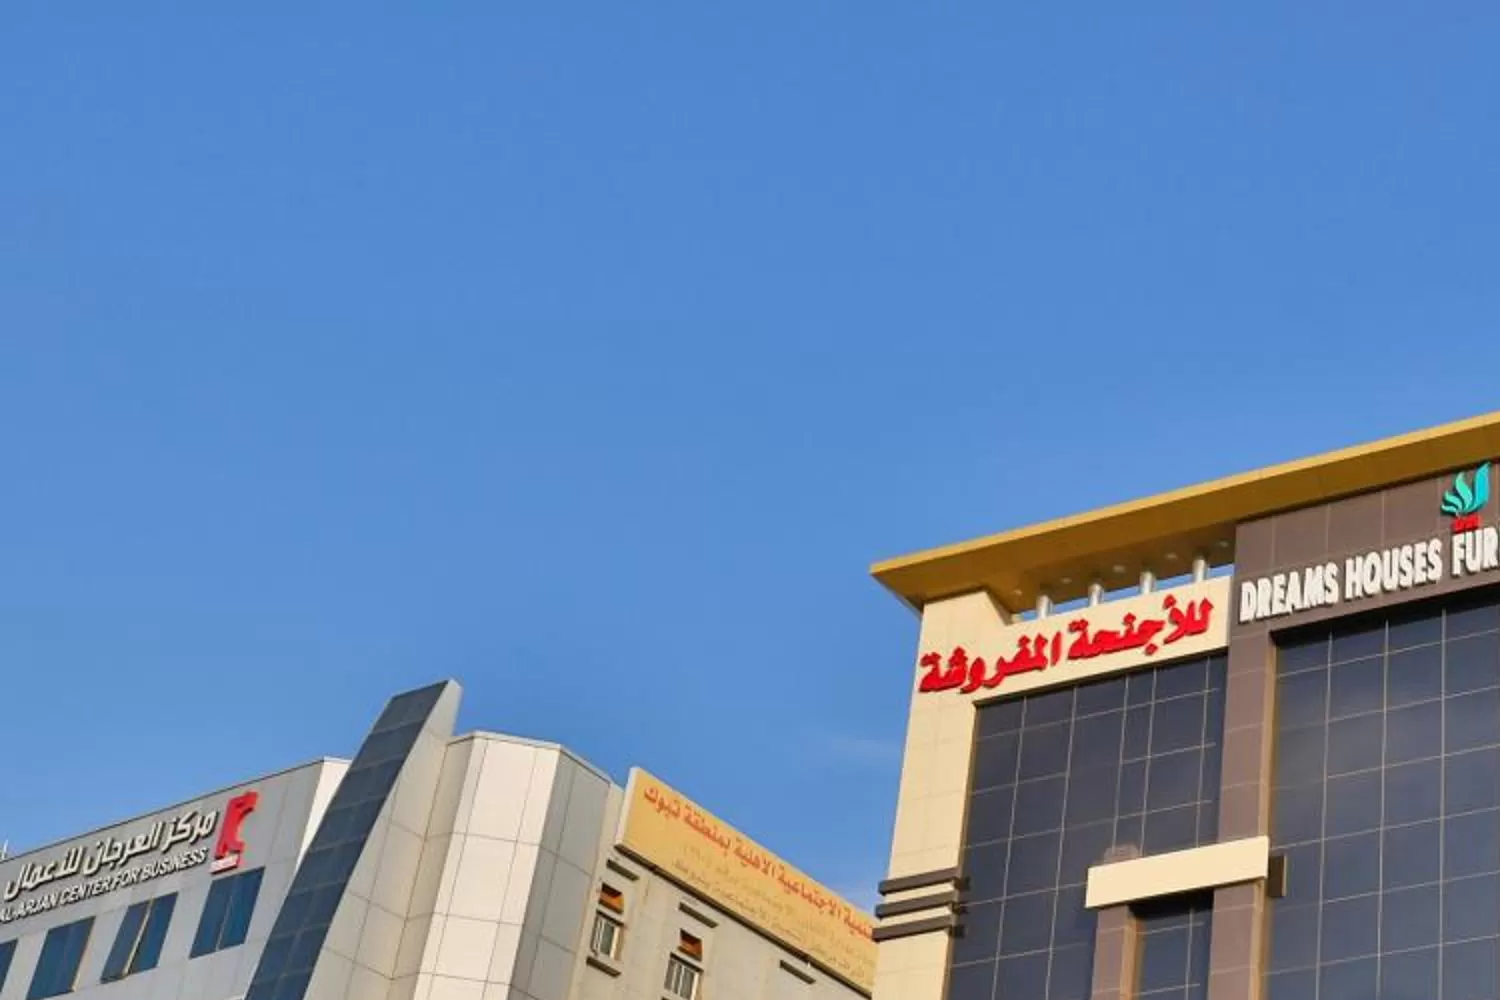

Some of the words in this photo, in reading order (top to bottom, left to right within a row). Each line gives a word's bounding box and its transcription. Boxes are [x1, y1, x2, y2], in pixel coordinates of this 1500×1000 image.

[1239, 563, 1339, 623] DREAMS
[1344, 537, 1443, 600] HOUSES
[1067, 594, 1213, 661] للأجنحة
[918, 631, 1064, 693] المفروشة
[161, 810, 219, 854] مركز
[60, 875, 112, 906] CENTER
[111, 867, 142, 891] FOR
[141, 847, 208, 881] BUSINESS
